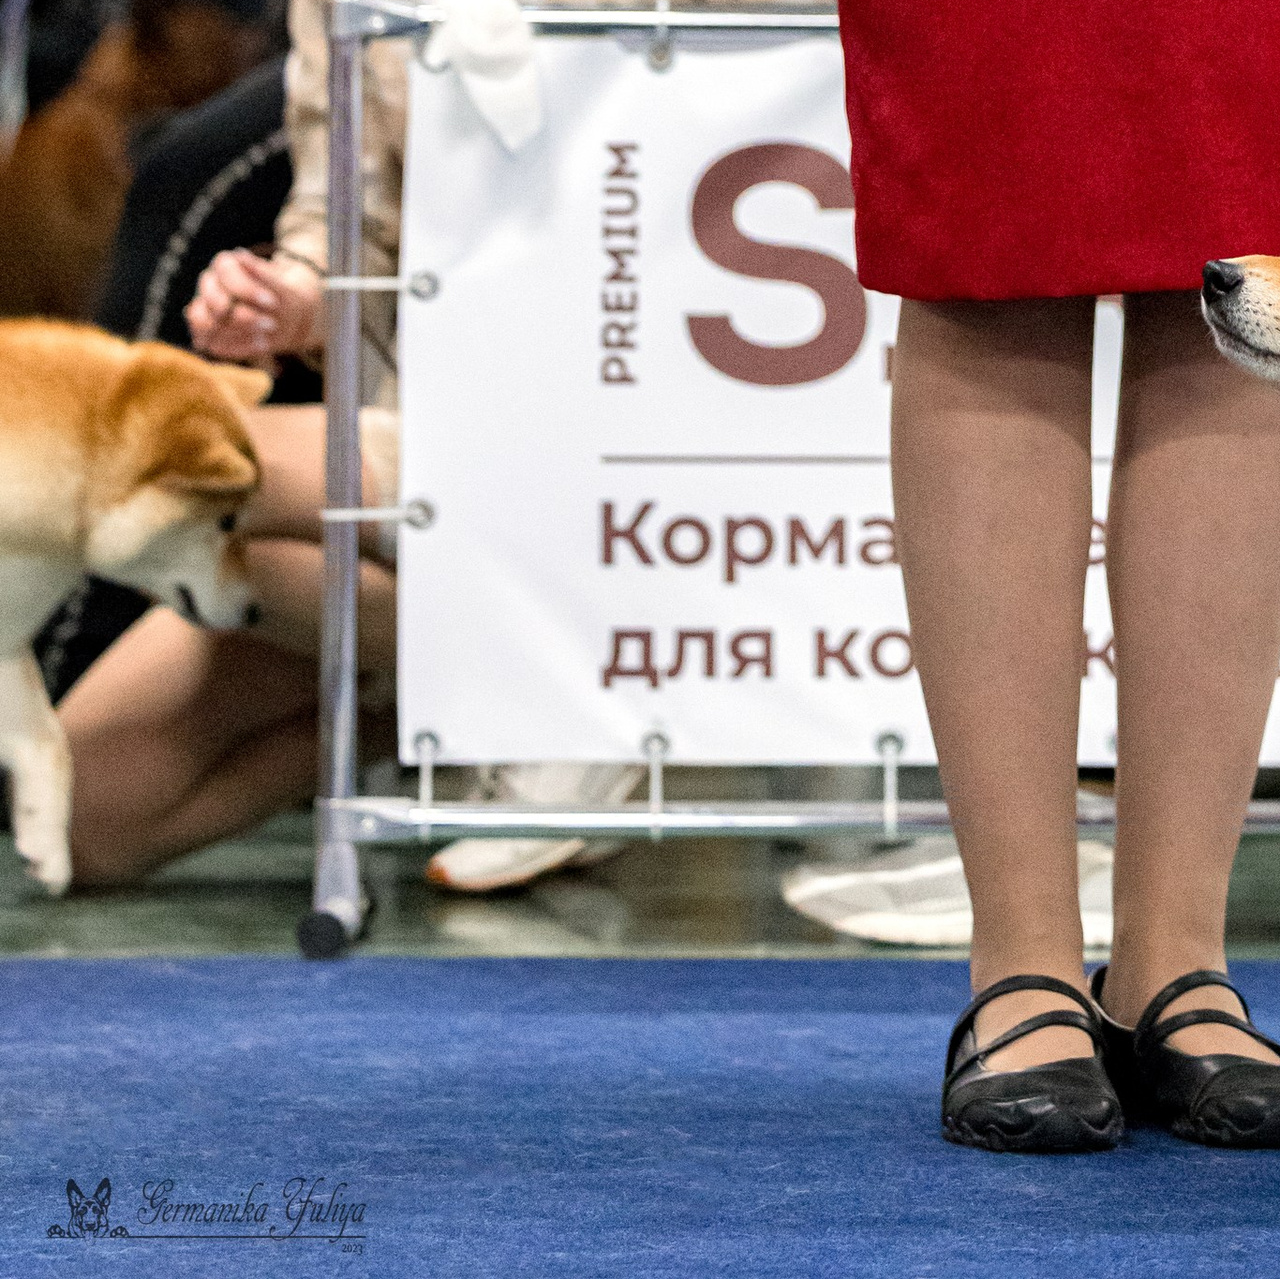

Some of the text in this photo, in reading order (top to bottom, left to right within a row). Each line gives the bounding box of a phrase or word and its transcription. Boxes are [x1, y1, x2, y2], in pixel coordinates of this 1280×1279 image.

[601, 143, 638, 385] PREMIUM
[601, 501, 903, 584] Корма
[602, 629, 774, 689] для
